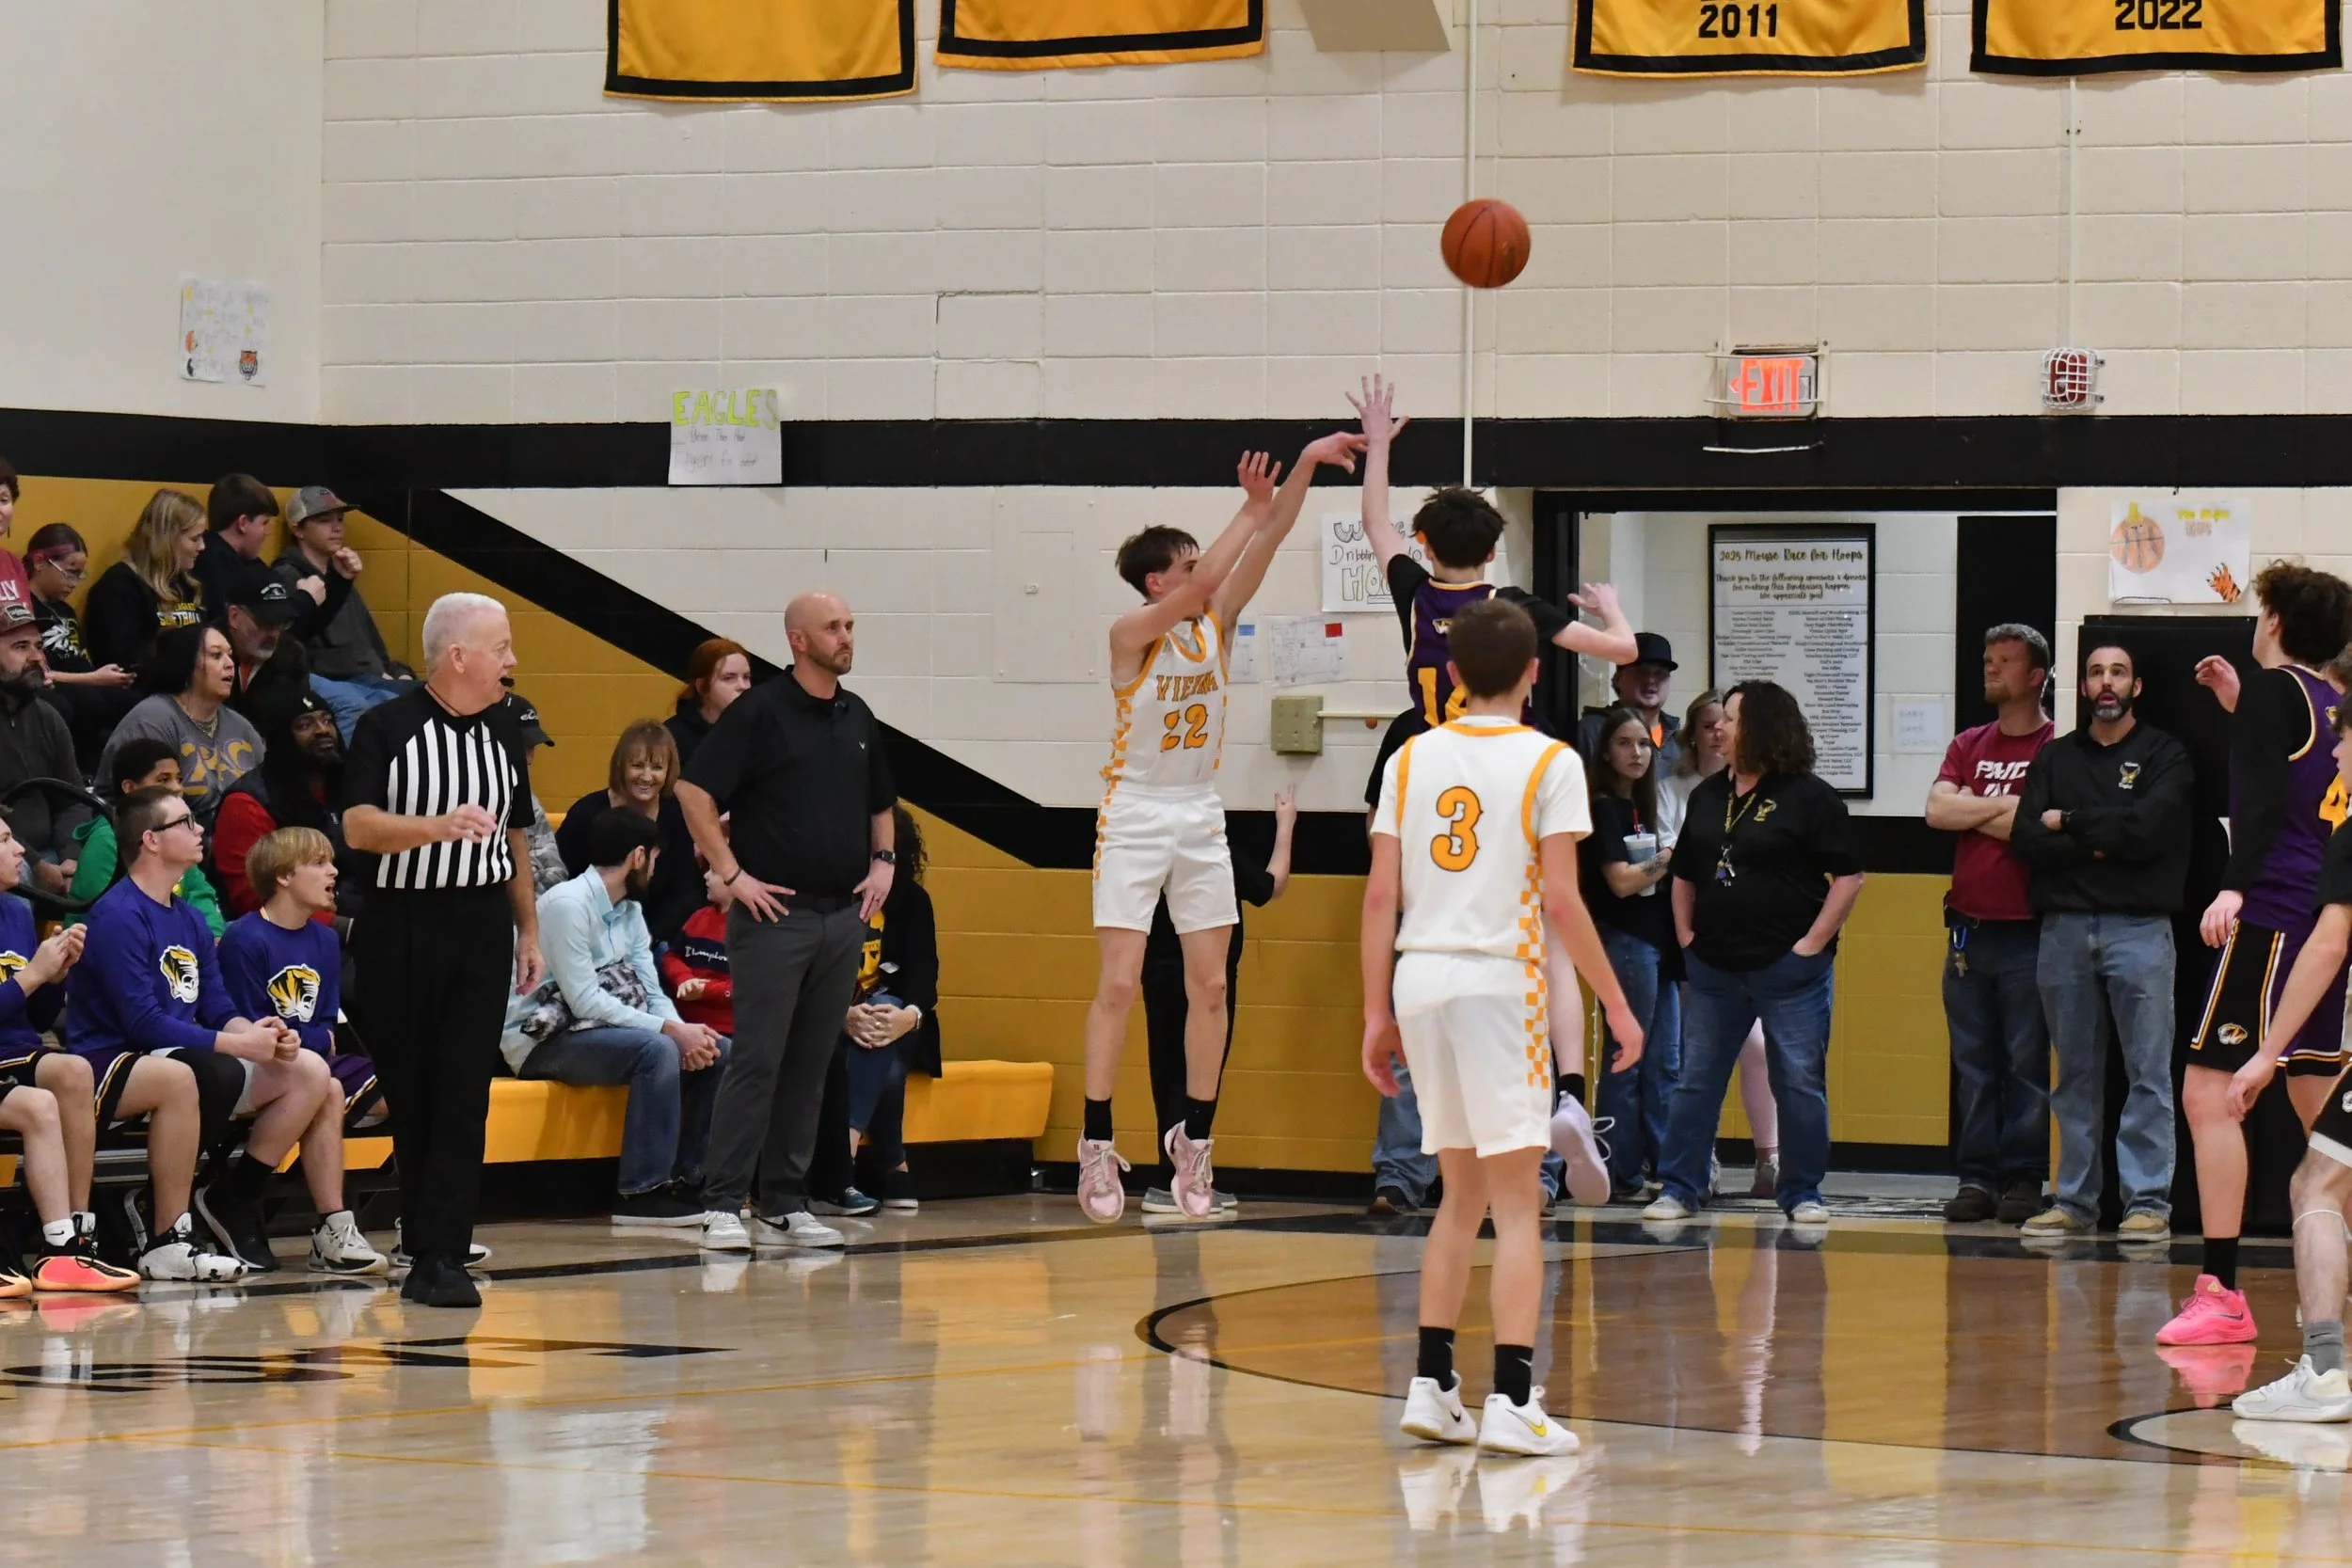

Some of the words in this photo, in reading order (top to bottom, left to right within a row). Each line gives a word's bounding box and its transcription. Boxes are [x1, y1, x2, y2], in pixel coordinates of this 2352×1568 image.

[1698, 4, 1777, 39] 2011
[2115, 0, 2201, 30] 2022
[1740, 357, 1804, 412] EXIT
[673, 388, 778, 431] EAGLES
[1784, 548, 1807, 562] Race
[1810, 548, 1828, 562] for
[1833, 548, 1863, 563] Hoops
[1160, 704, 1208, 753] 22
[1430, 785, 1483, 872] 3
